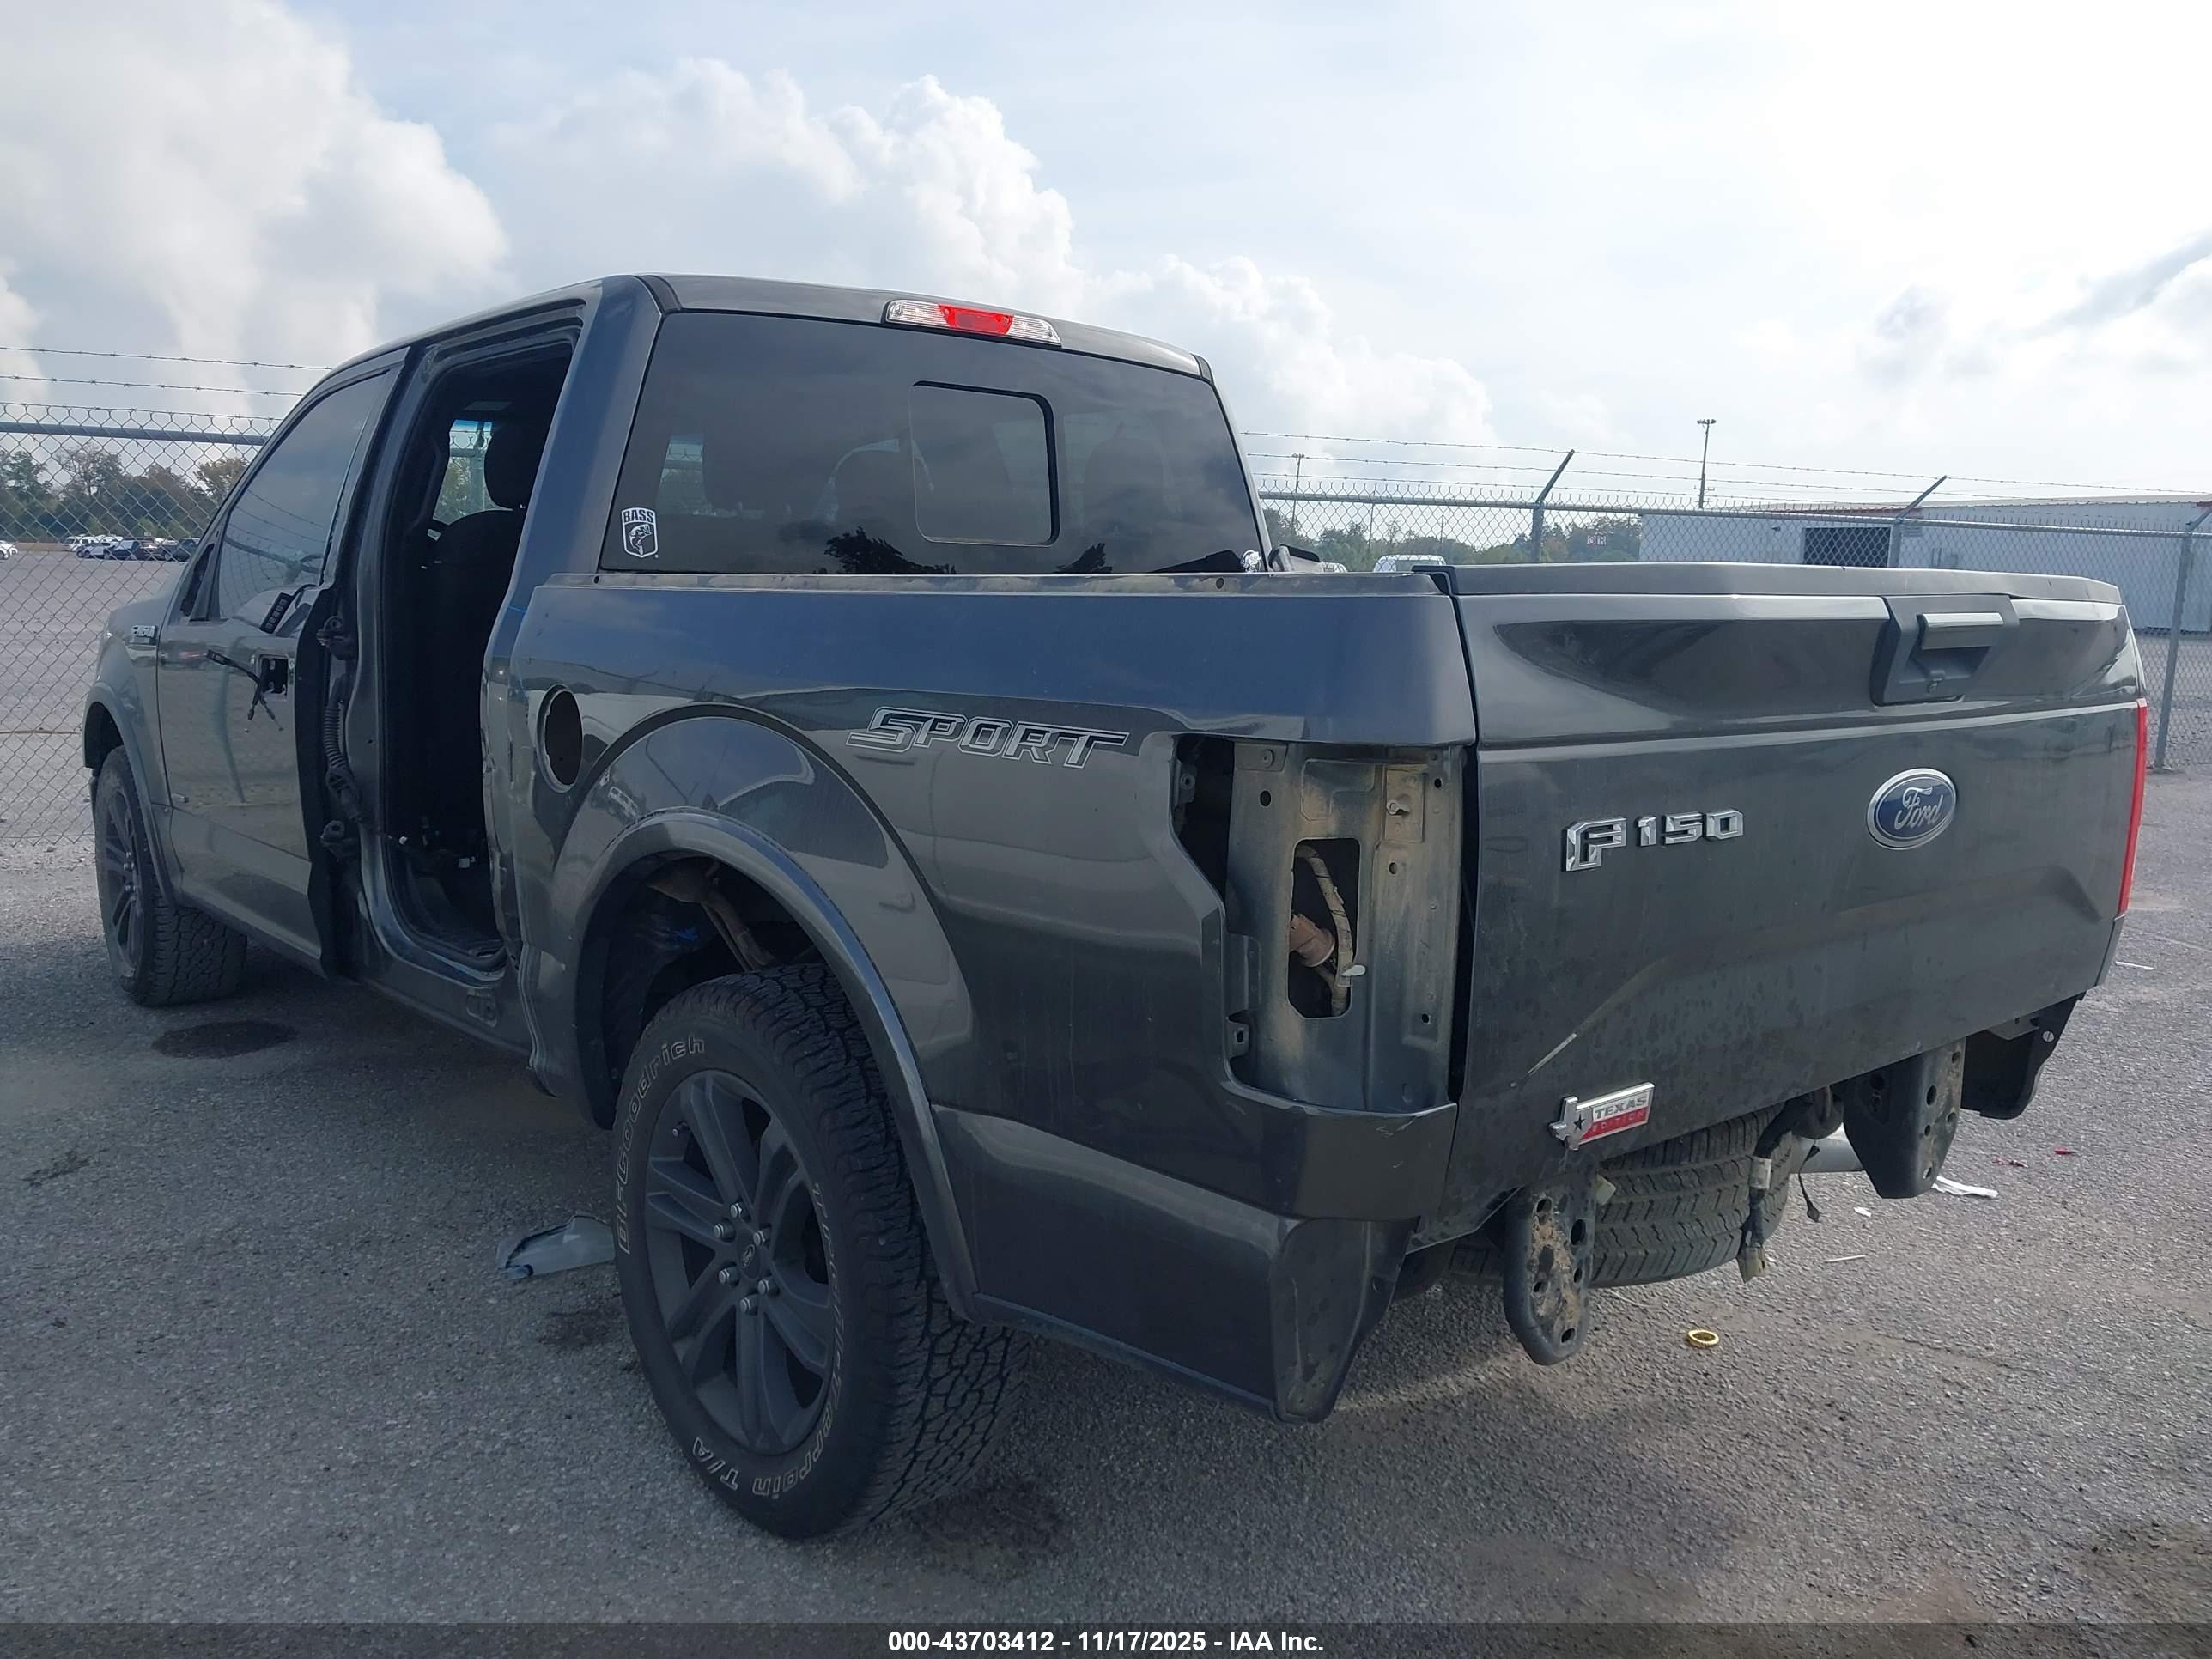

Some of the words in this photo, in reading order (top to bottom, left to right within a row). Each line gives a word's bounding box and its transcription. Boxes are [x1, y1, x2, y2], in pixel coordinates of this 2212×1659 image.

[623, 509, 653, 522] BASS
[845, 706, 1130, 769] SPORT
[1894, 787, 1944, 830] Ford
[1595, 1096, 1647, 1119] TEXAS
[616, 1034, 705, 1255] BFGoodrich
[692, 1436, 739, 1492] T/A
